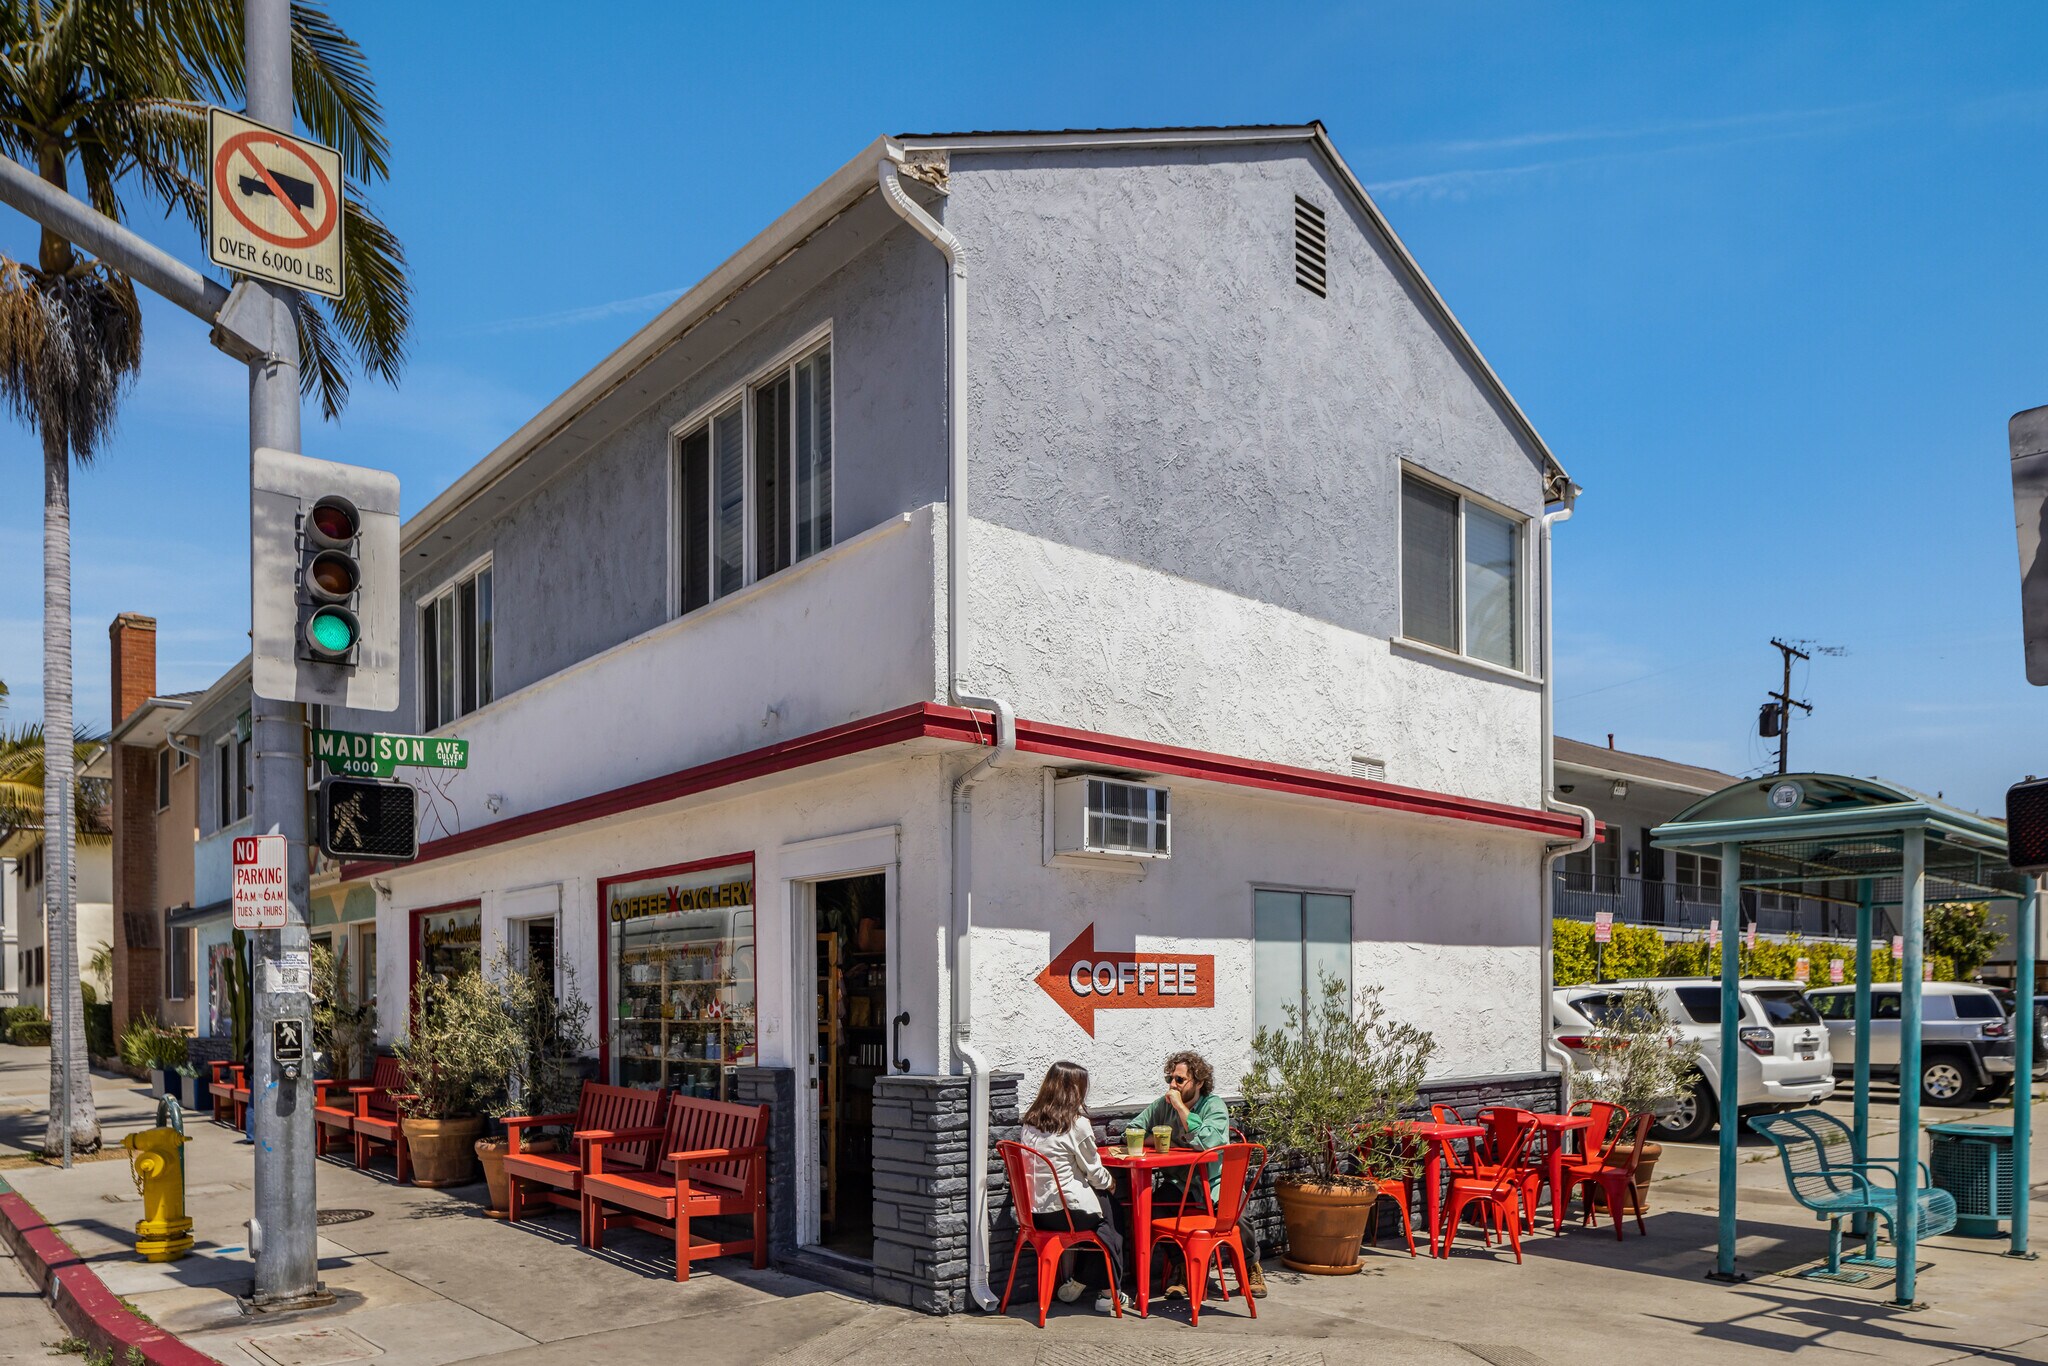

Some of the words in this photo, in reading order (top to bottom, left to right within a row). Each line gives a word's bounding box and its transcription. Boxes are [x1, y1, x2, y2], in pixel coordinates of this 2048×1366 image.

[219, 236, 256, 263] OVER
[307, 262, 336, 286] LBS.
[318, 733, 425, 762] MADISON
[436, 742, 464, 755] AVE.
[437, 752, 463, 761] CULVER
[343, 760, 379, 774] 4000
[442, 759, 458, 767] CITY
[236, 840, 255, 862] NO
[237, 867, 282, 885] PARKING
[237, 906, 255, 917] TUES.
[256, 907, 261, 916] &
[263, 905, 285, 916] THURS.
[611, 892, 667, 922] COFFEE
[679, 880, 752, 911] CYCLERY
[1069, 960, 1197, 997] COFFEE
